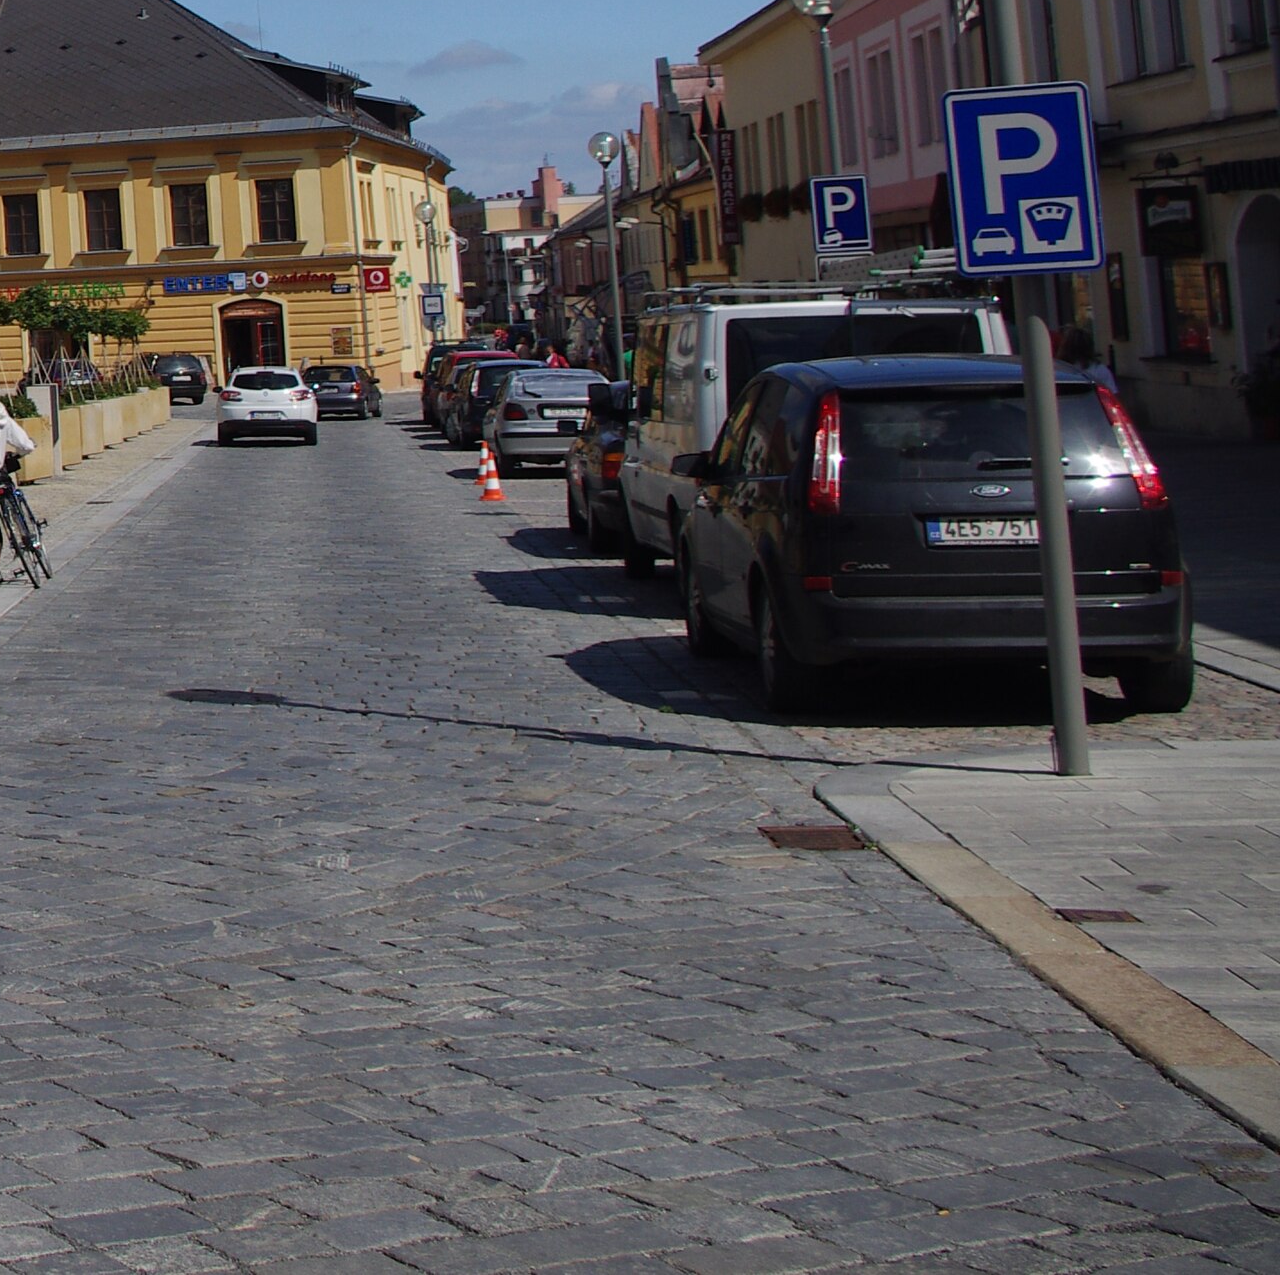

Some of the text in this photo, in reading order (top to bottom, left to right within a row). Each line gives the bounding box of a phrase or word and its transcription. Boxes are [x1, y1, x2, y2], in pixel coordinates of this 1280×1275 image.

[721, 133, 735, 215] RESTAURACE
[977, 113, 1058, 215] P
[823, 185, 856, 228] P
[163, 274, 229, 292] ENTER
[272, 270, 336, 284] vodafone
[944, 518, 1037, 538] 4E5 751
